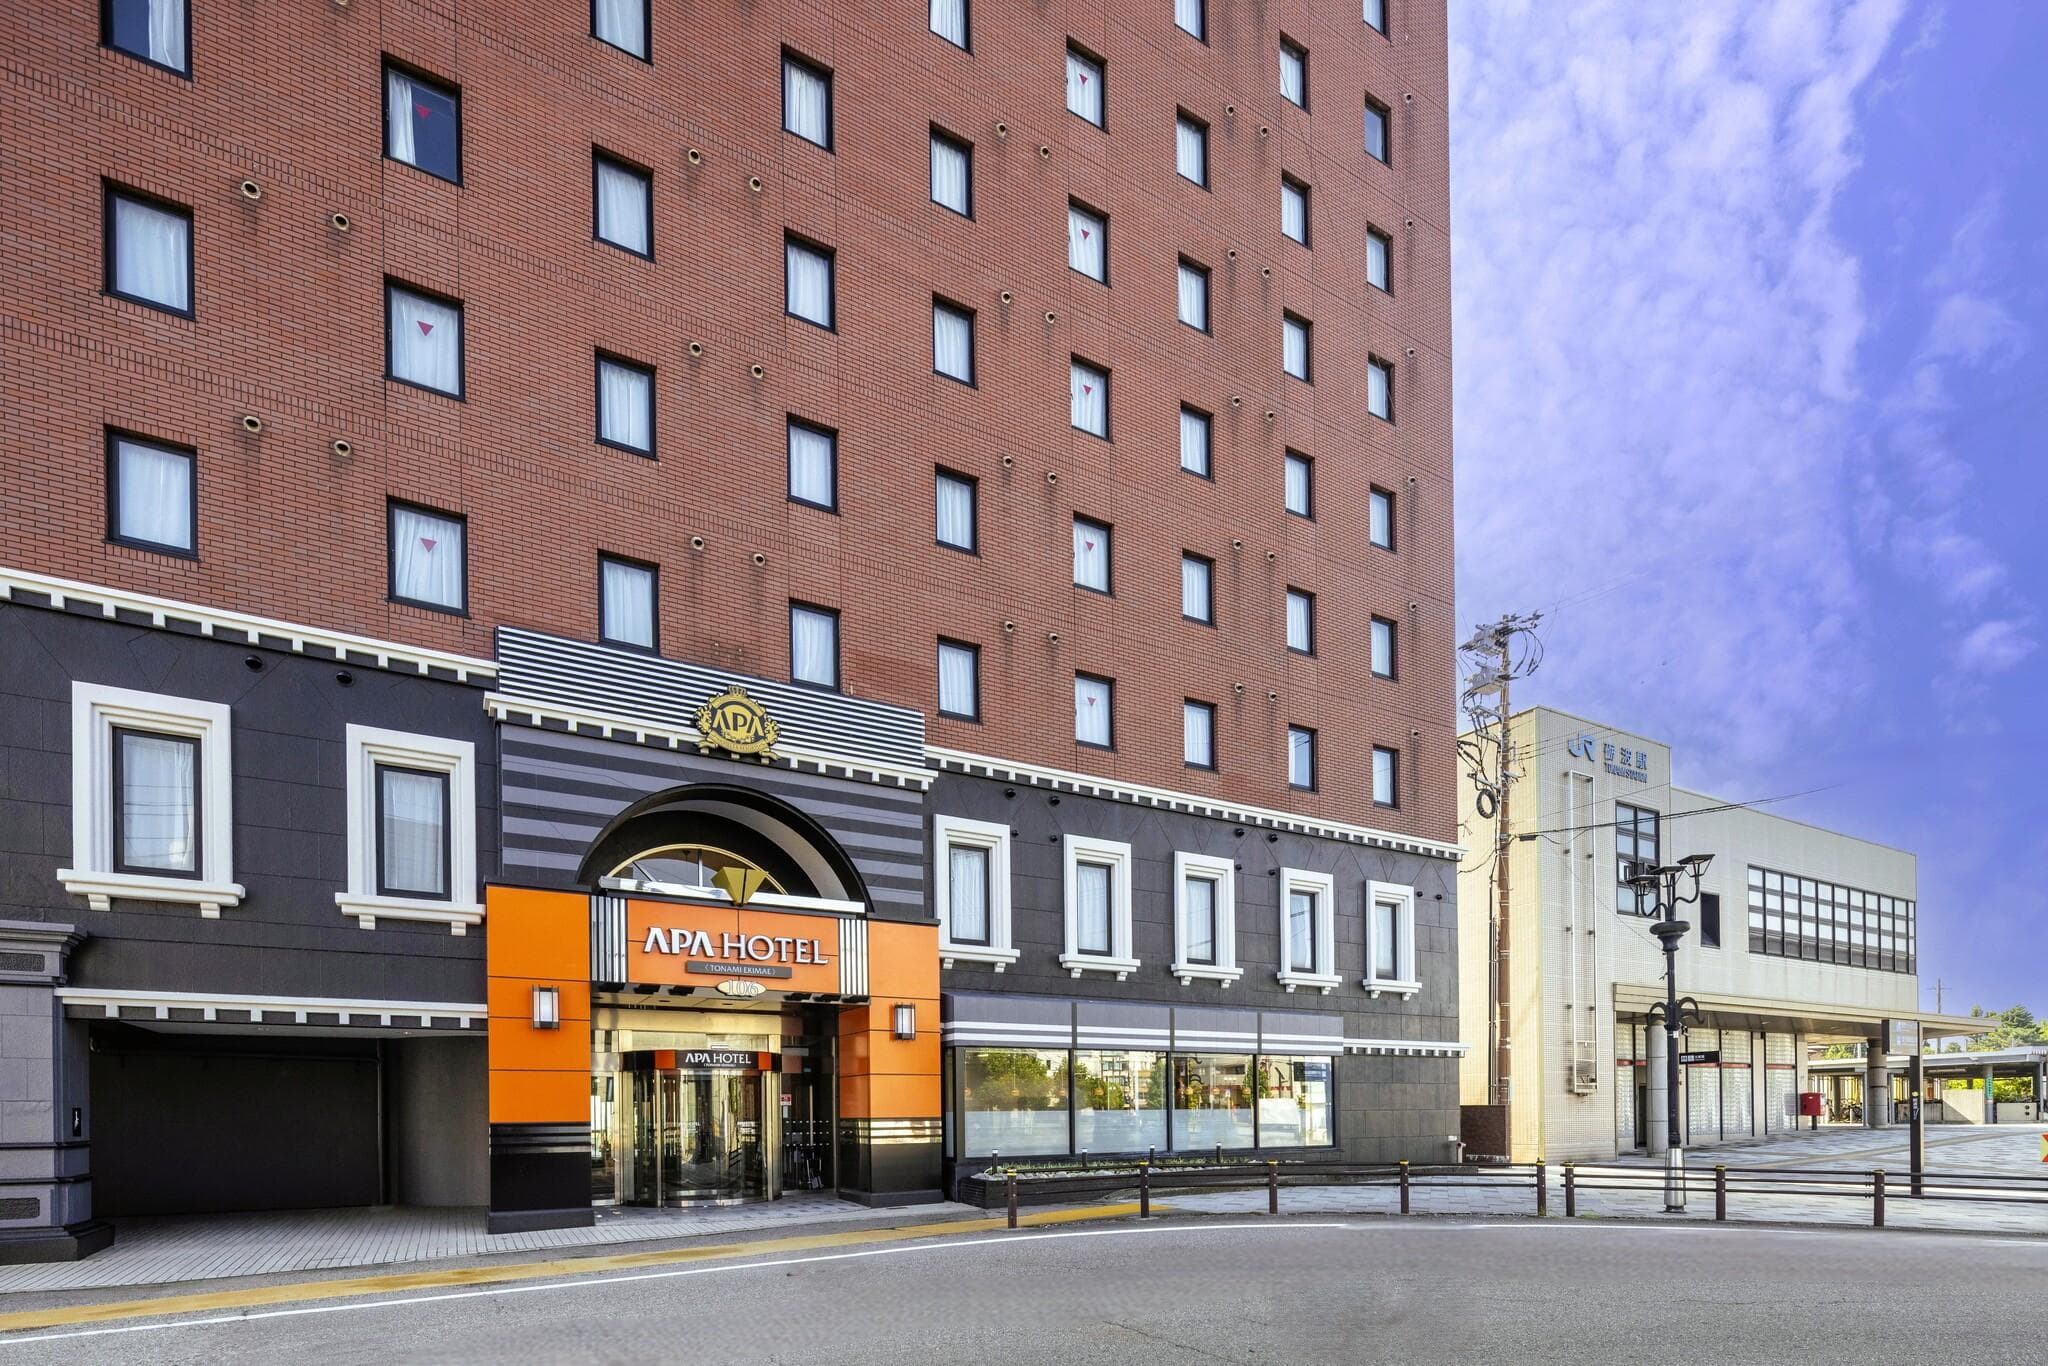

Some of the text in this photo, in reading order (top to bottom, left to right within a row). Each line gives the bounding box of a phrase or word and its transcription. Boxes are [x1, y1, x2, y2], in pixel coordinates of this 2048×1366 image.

[712, 709, 765, 738] APA
[1568, 735, 1596, 762] JR
[643, 926, 829, 965] APA HOTEL
[728, 980, 760, 997] 106
[685, 1053, 752, 1064] APA HOTEL
